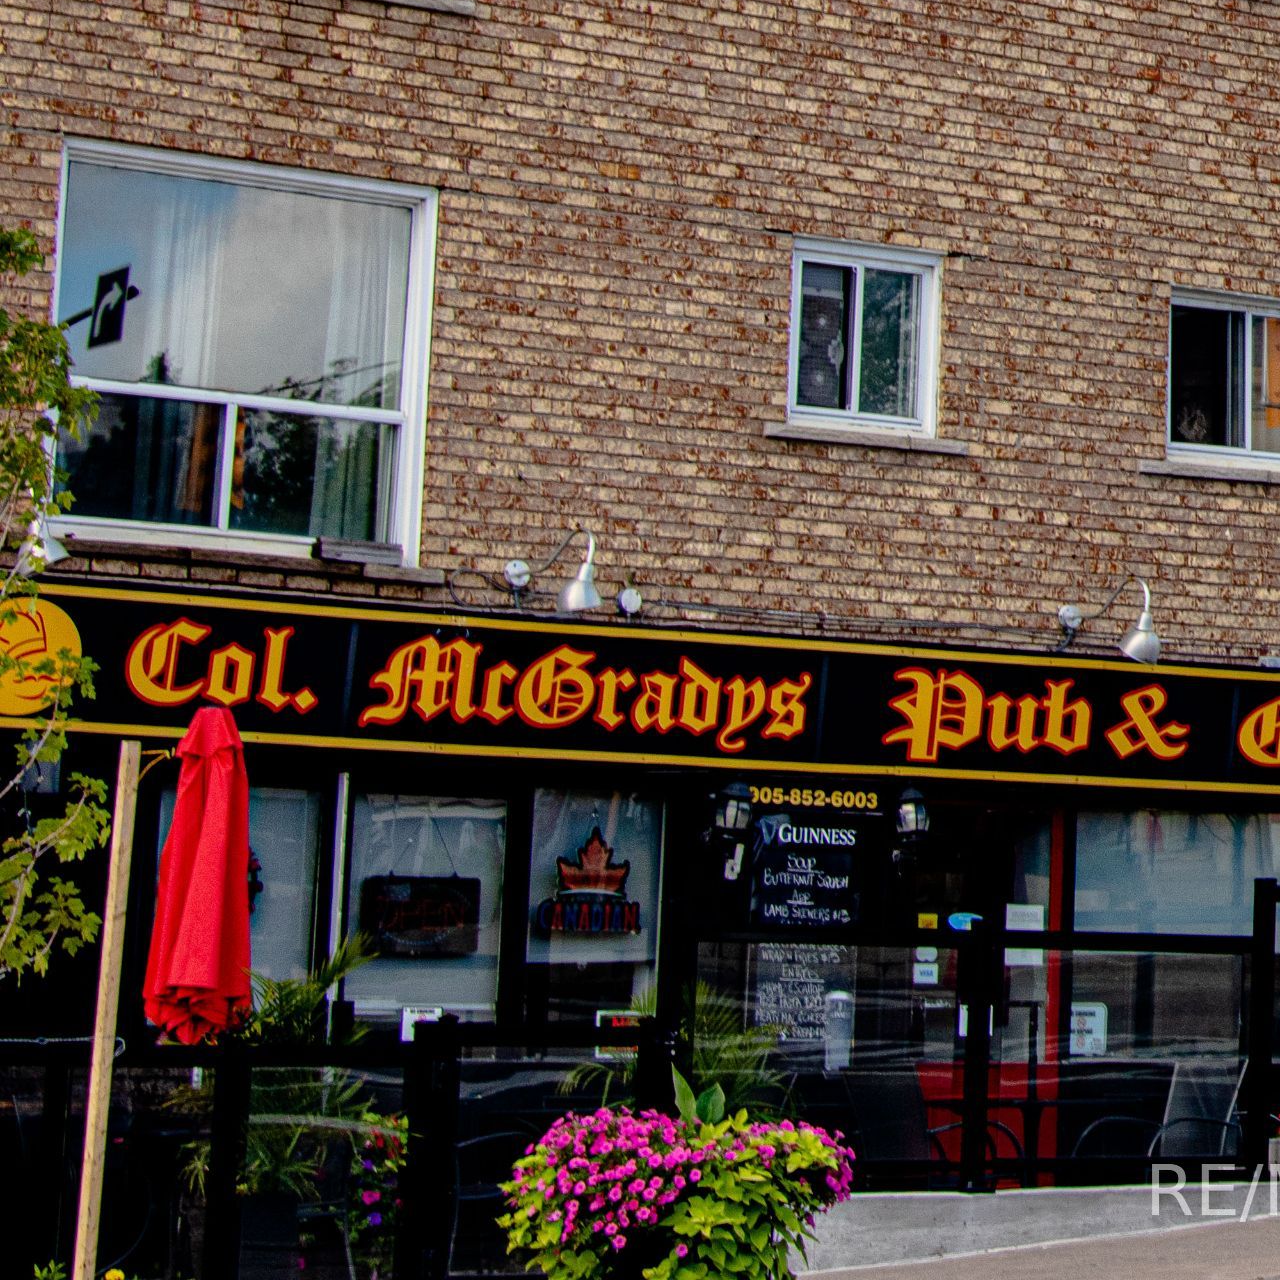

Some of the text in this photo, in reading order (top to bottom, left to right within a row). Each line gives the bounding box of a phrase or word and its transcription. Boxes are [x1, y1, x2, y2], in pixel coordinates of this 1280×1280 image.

[124, 617, 318, 713] Col.
[358, 634, 812, 752] McGradys
[881, 666, 1092, 762] Pub
[1105, 683, 1190, 761] &
[778, 823, 857, 846] GUINNESS
[537, 898, 641, 933] CANADIAN
